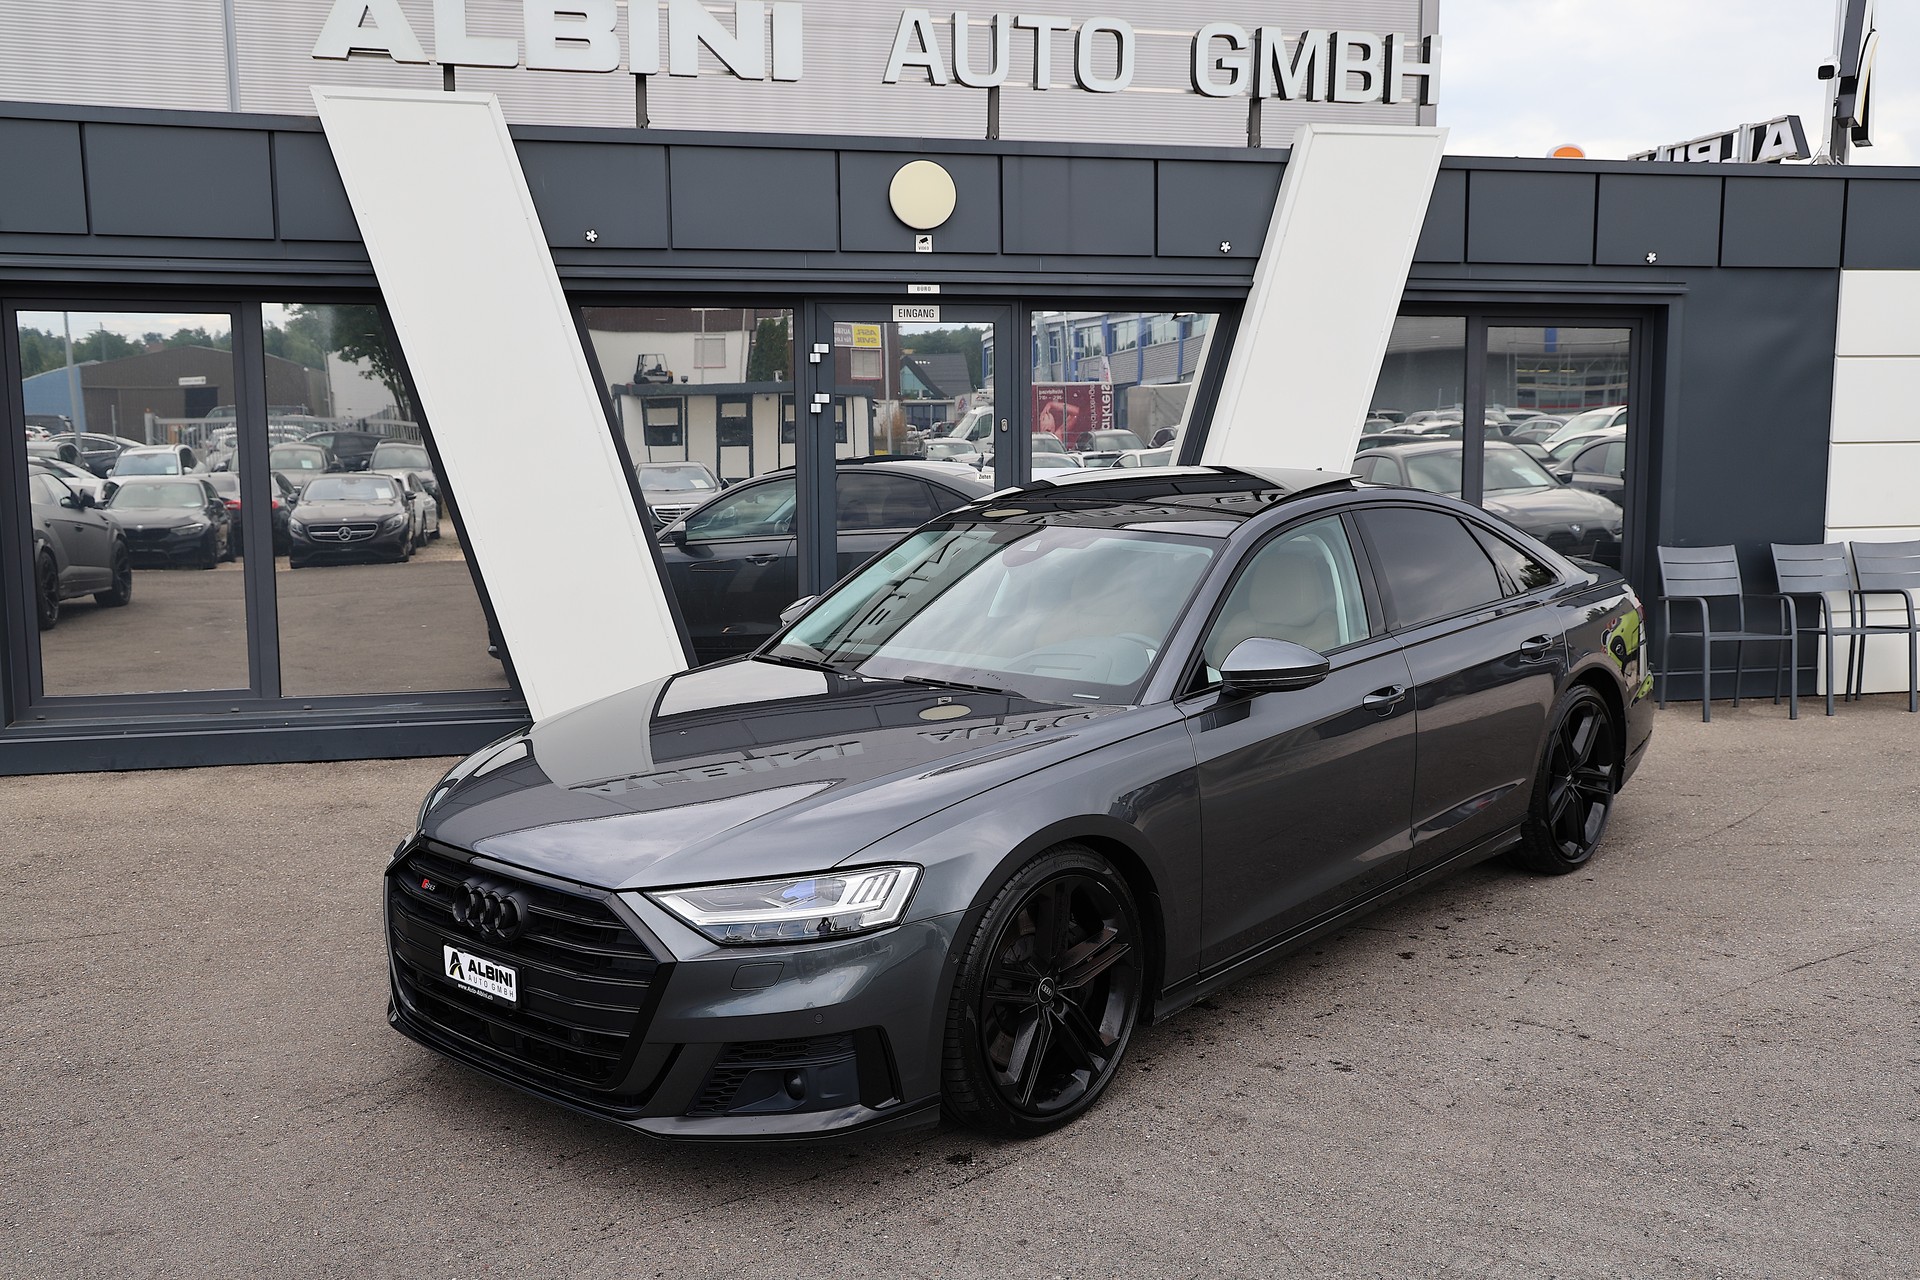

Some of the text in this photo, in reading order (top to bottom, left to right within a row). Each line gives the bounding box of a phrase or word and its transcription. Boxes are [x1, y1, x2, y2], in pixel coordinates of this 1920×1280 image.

[312, 0, 1442, 105] ALBINI AUTO GMBH
[898, 308, 935, 318] EINGANG
[468, 959, 513, 987] ALBINI
[468, 975, 514, 998] AUTO GMBH
